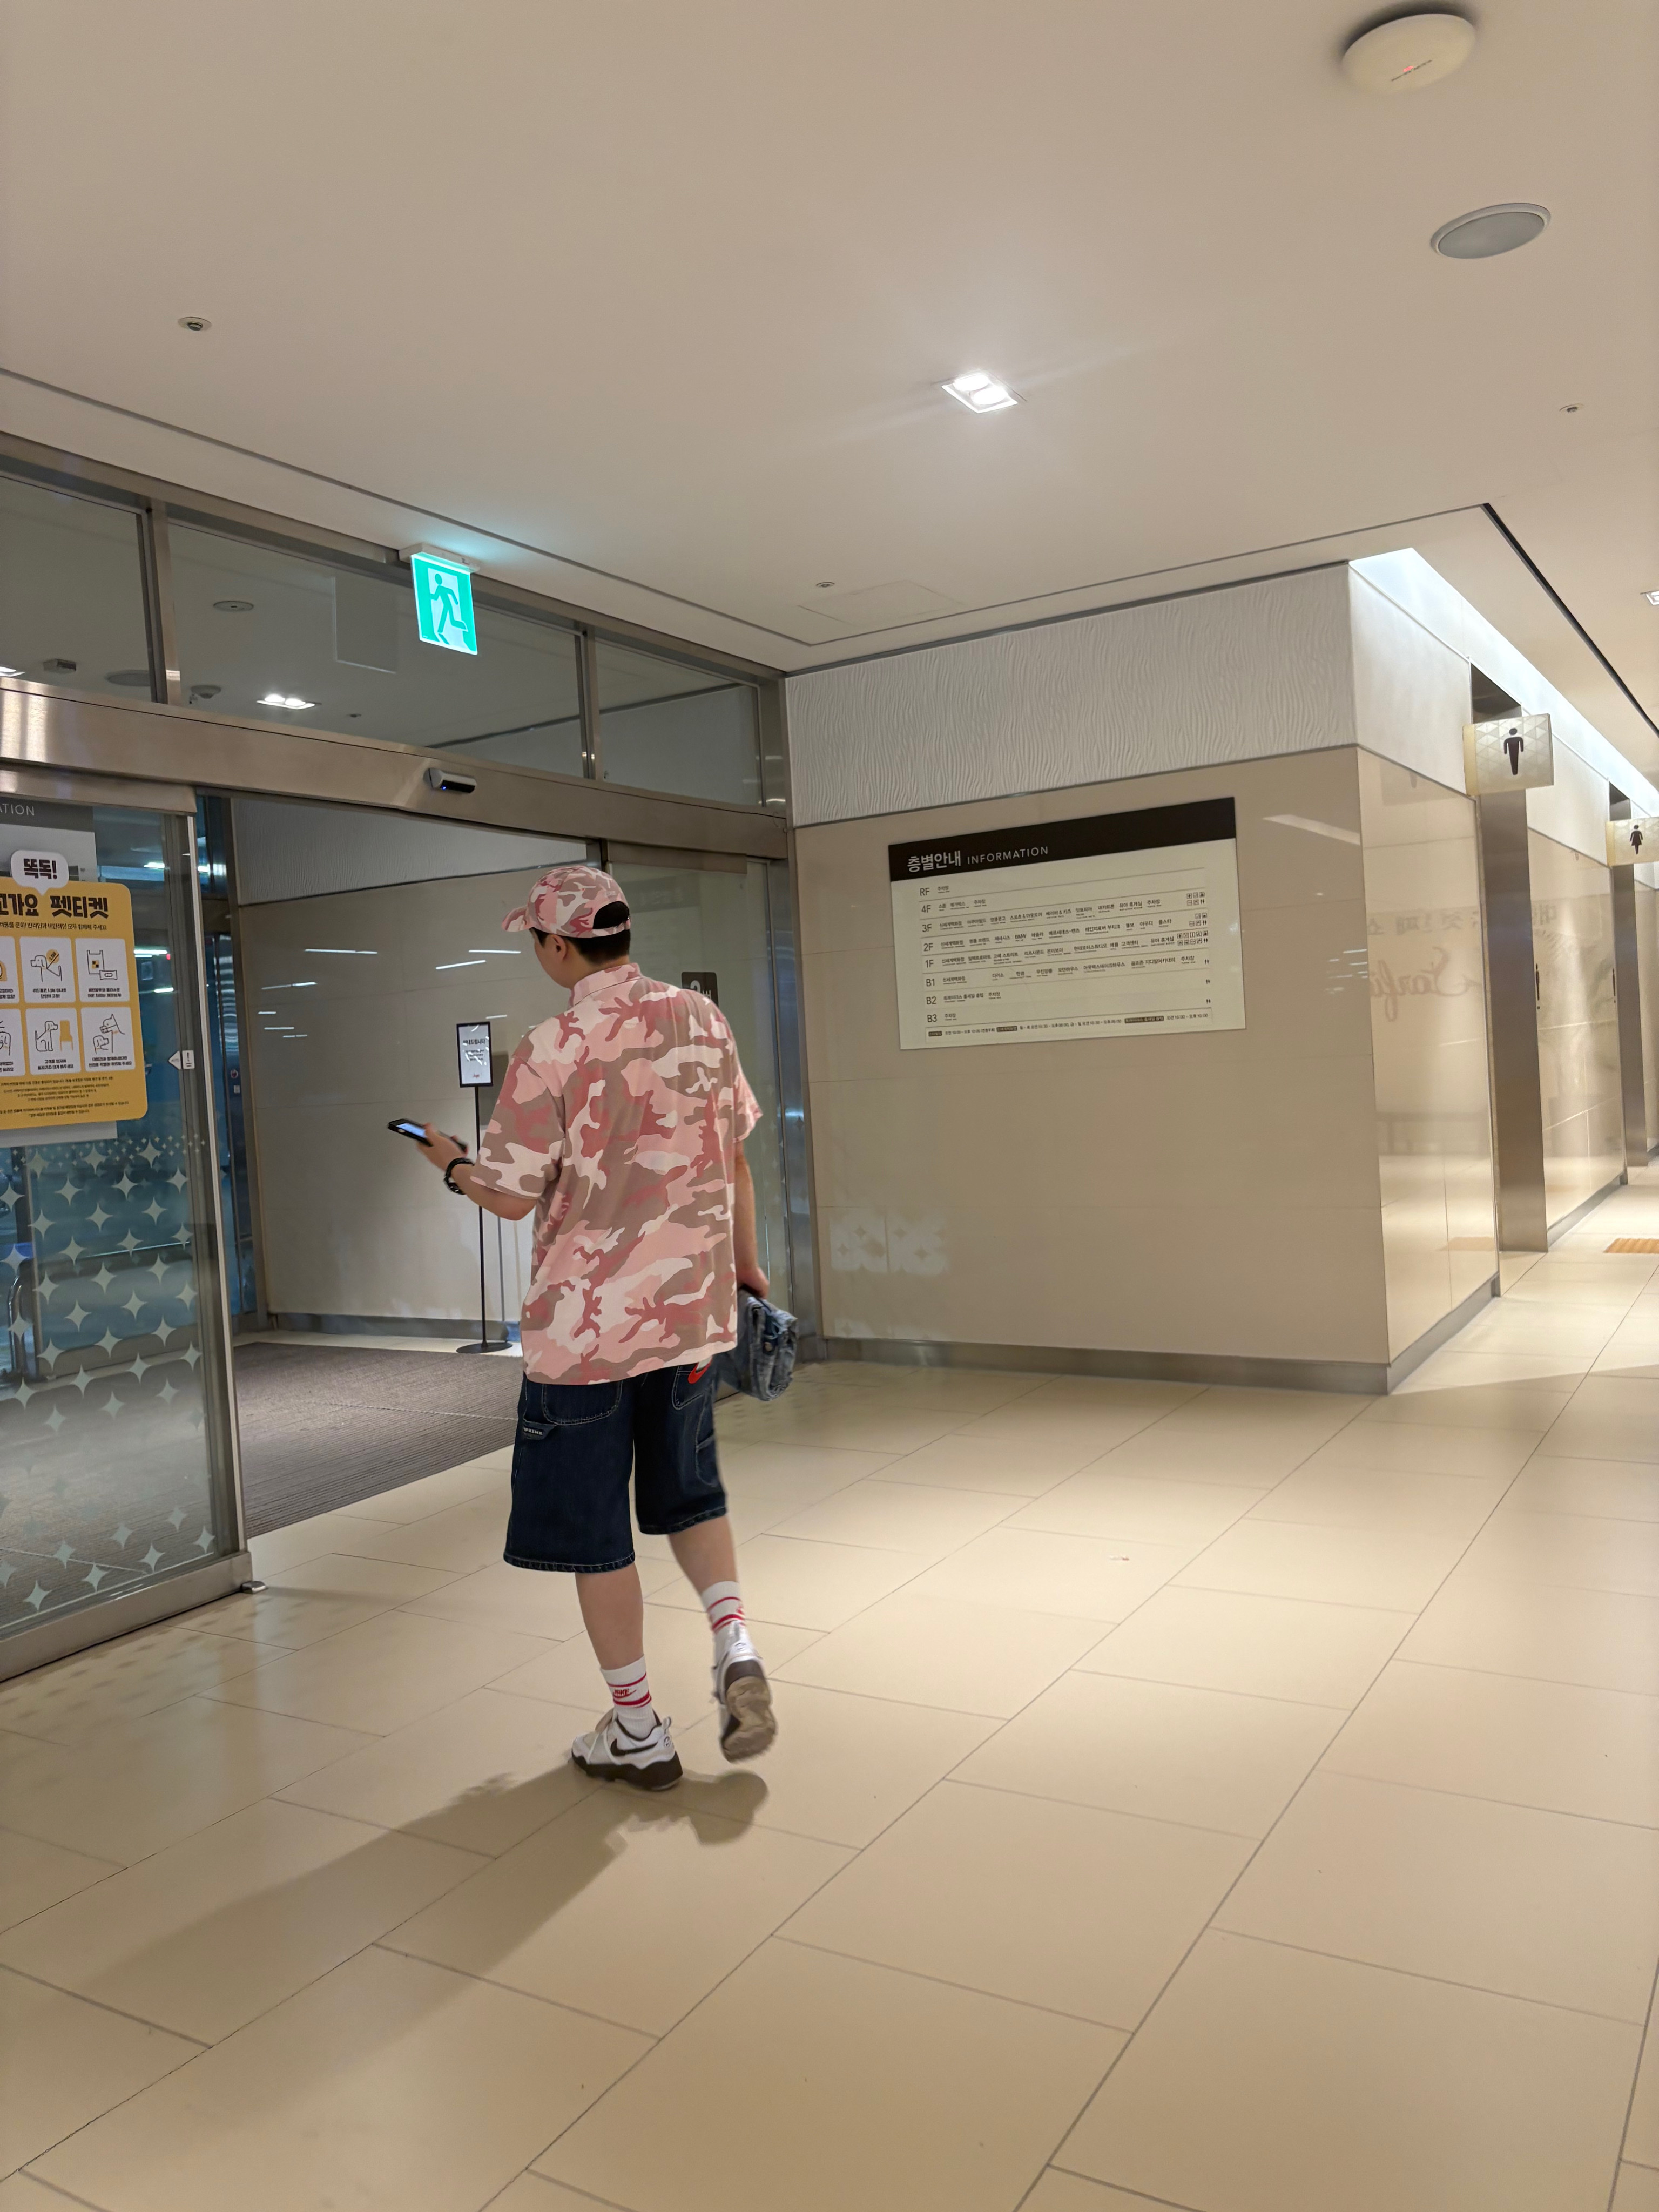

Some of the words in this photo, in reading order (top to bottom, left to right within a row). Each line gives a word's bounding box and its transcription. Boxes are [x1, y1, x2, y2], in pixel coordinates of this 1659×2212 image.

[907, 850, 961, 873] 층별안내
[967, 846, 1048, 864] INFORMATION
[24, 858, 58, 879] 똑독!
[919, 887, 930, 896] RF
[50, 895, 109, 919] 펫티켓
[921, 905, 931, 913] 4F
[921, 923, 932, 932] 3F
[923, 942, 933, 952] 2F
[925, 959, 934, 968] 1F
[925, 978, 935, 987] B1
[927, 1014, 937, 1022] B3
